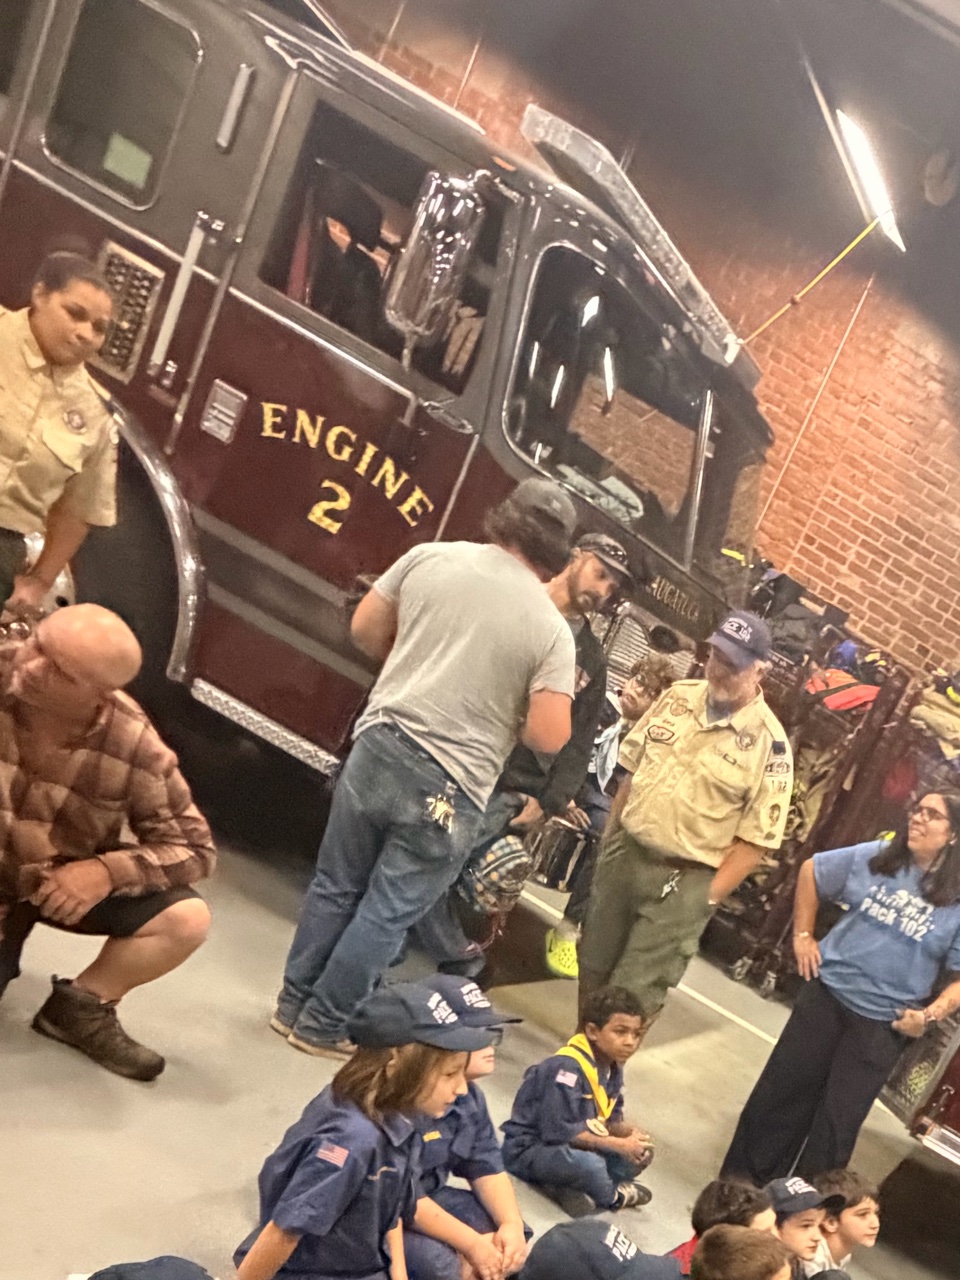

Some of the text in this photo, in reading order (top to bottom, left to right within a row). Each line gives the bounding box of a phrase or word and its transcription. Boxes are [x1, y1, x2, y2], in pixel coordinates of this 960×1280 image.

[260, 401, 435, 527] ENGINE
[307, 479, 351, 534] 2
[899, 917, 928, 942] 102
